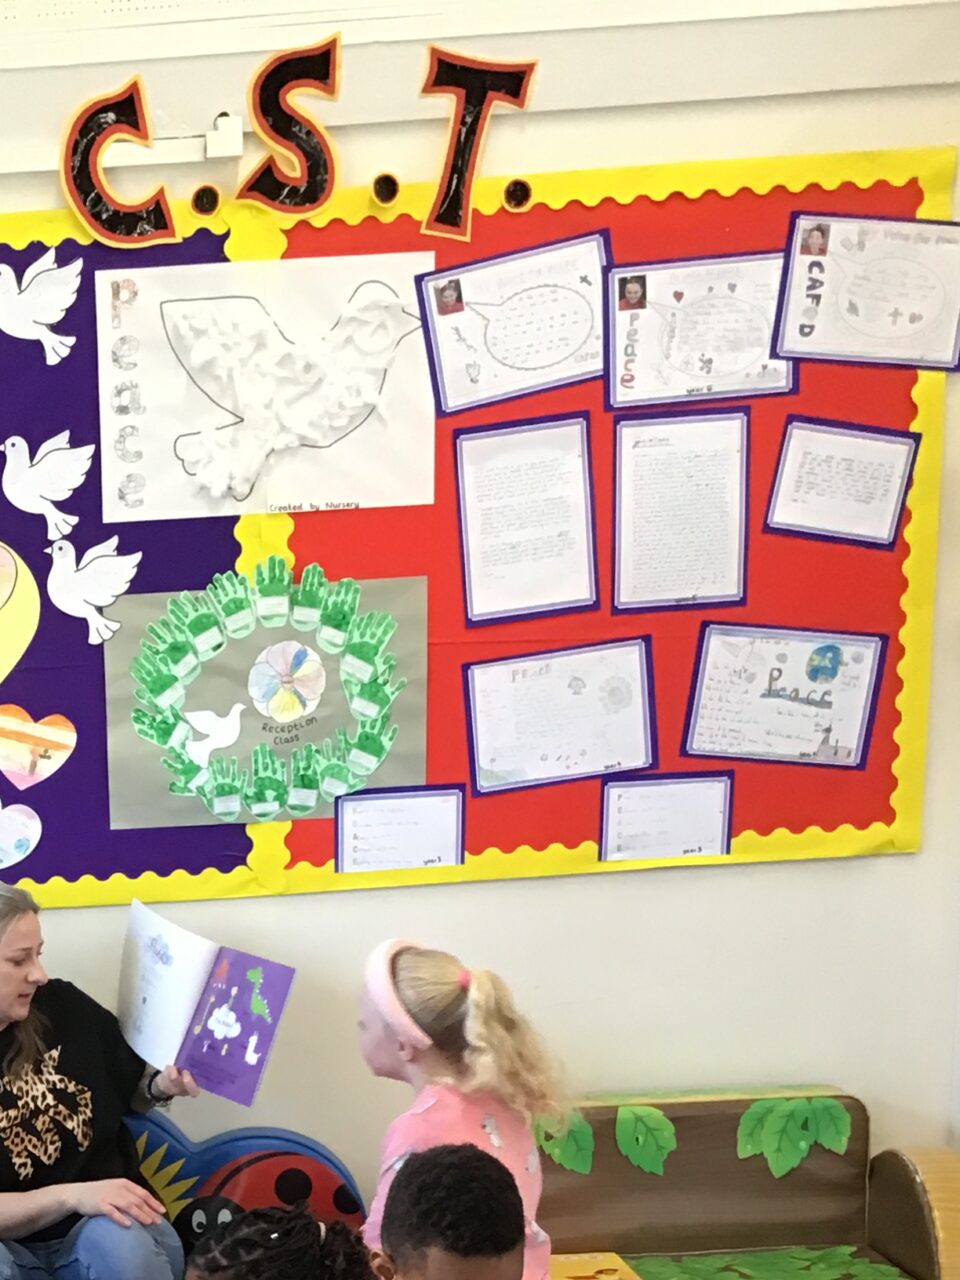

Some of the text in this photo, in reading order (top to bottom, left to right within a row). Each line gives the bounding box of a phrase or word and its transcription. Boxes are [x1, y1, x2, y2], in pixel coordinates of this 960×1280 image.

[269, 503, 303, 512] Created
[309, 503, 320, 511] by
[262, 716, 318, 735] Reception
[273, 734, 300, 746] Class
